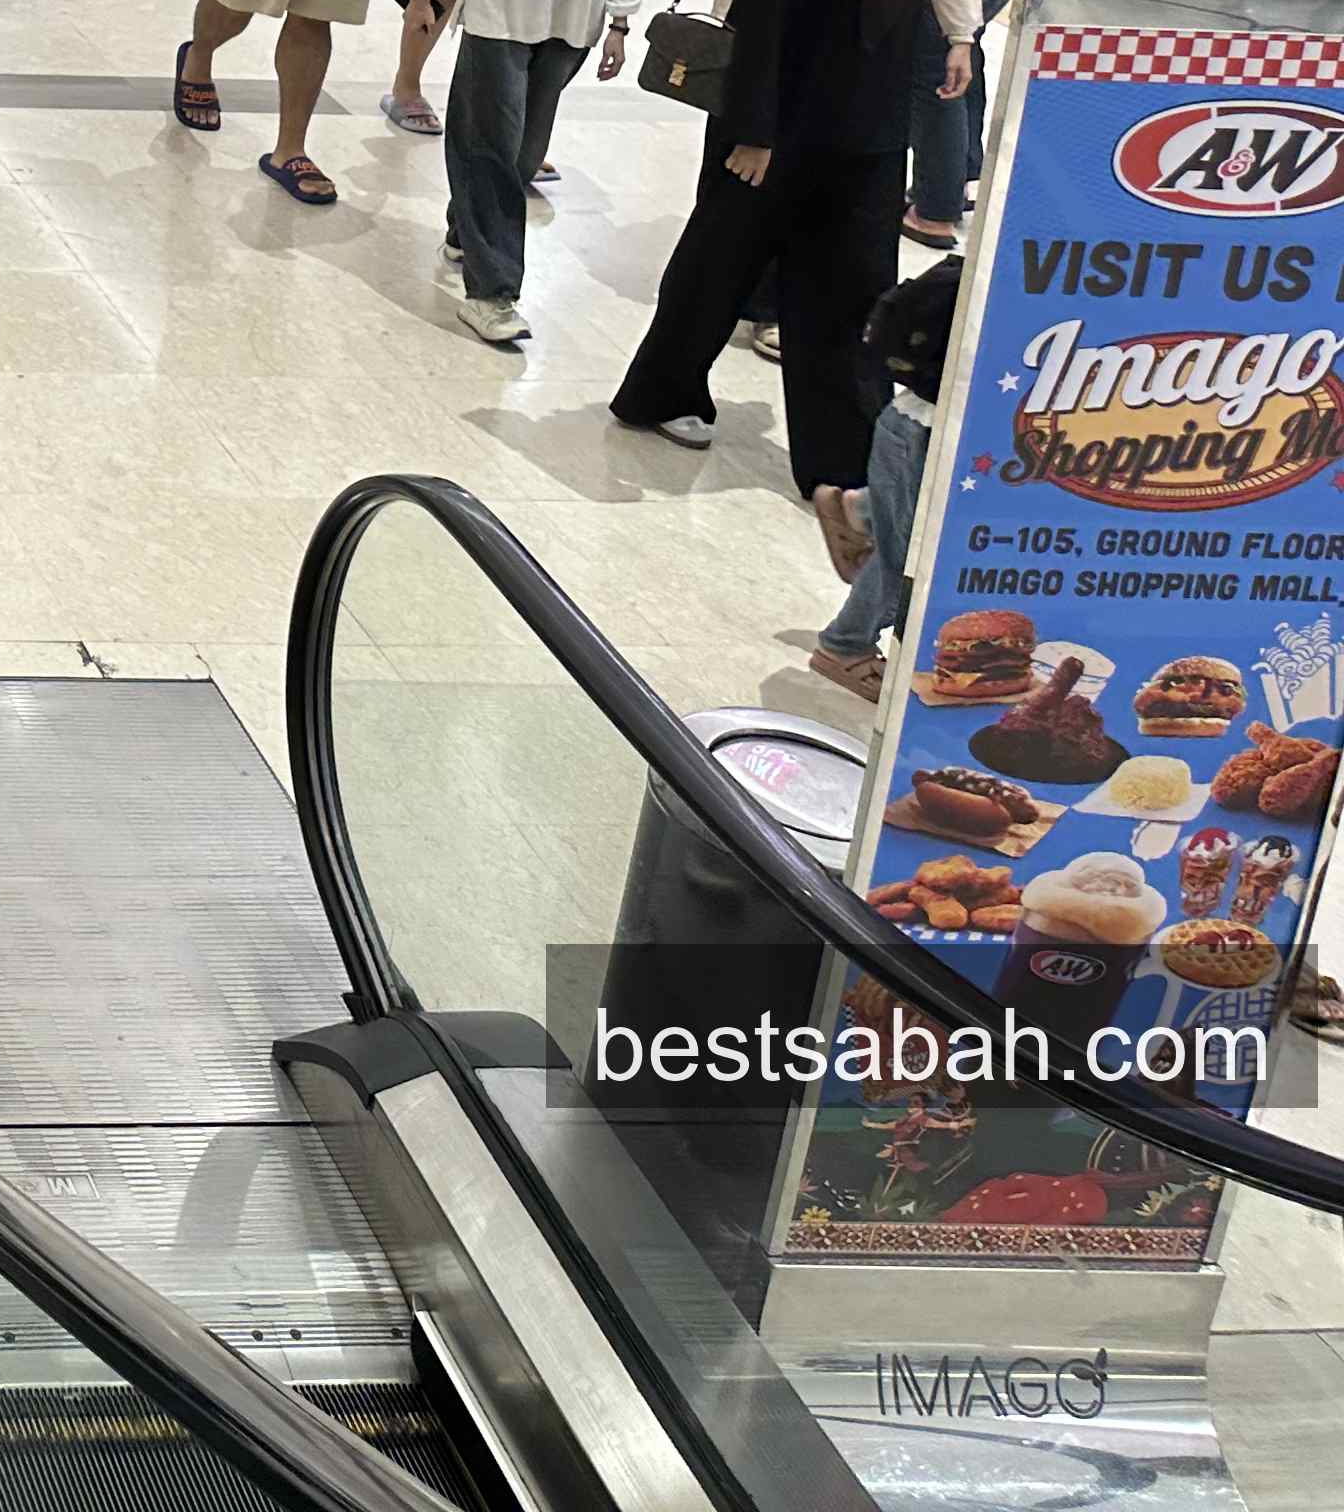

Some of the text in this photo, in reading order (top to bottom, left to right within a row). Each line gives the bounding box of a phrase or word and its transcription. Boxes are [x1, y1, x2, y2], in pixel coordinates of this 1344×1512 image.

[1148, 126, 1344, 196] A&W
[1021, 239, 1203, 299] VISIT
[1223, 245, 1316, 303] US
[1022, 319, 1344, 429] Imago
[1000, 418, 1266, 491] Shopping
[969, 524, 1344, 561] G-105, GROUND FLOOR
[956, 567, 1064, 598] IMAGO
[1074, 569, 1238, 602] SHOPPING
[874, 1352, 1108, 1420] IMAGO
